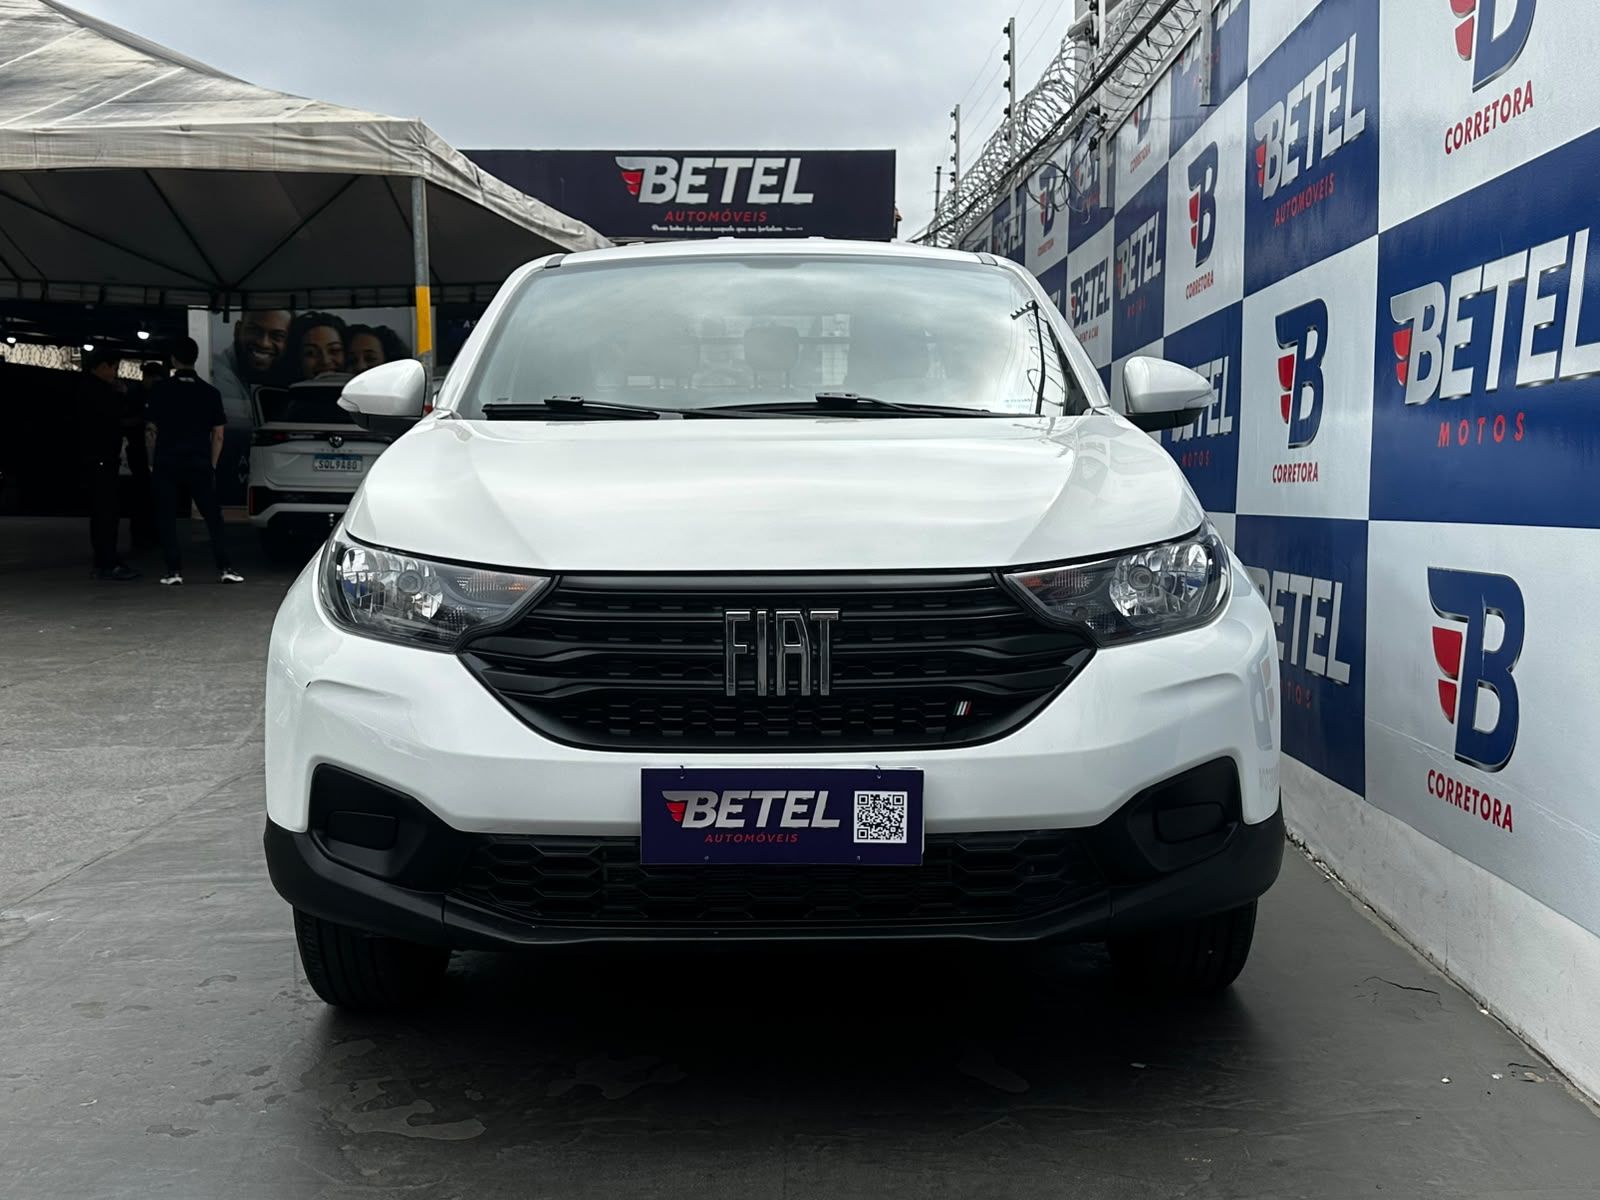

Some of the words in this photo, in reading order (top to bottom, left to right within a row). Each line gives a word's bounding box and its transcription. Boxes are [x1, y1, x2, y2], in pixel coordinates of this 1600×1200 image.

[1253, 33, 1366, 200] BETEL
[1444, 80, 1535, 155] CORRETORA
[615, 155, 815, 204] BETEL
[1274, 172, 1335, 227] AUTOMÓVEIS
[664, 208, 768, 222] AUTOMÓVEIS
[1117, 210, 1162, 300] BETEL
[1185, 270, 1215, 300] CORRETORA
[1070, 257, 1110, 328] BETEL
[1390, 227, 1600, 406] BETEL
[1171, 356, 1233, 442] TEL
[1438, 412, 1526, 448] MOTOS
[1271, 462, 1319, 484] CORRETORA
[724, 609, 840, 697] FIAT
[661, 789, 841, 829] BETEL
[1427, 768, 1514, 833] CORRETORA
[704, 832, 799, 844] AUTOMÓVEIS
